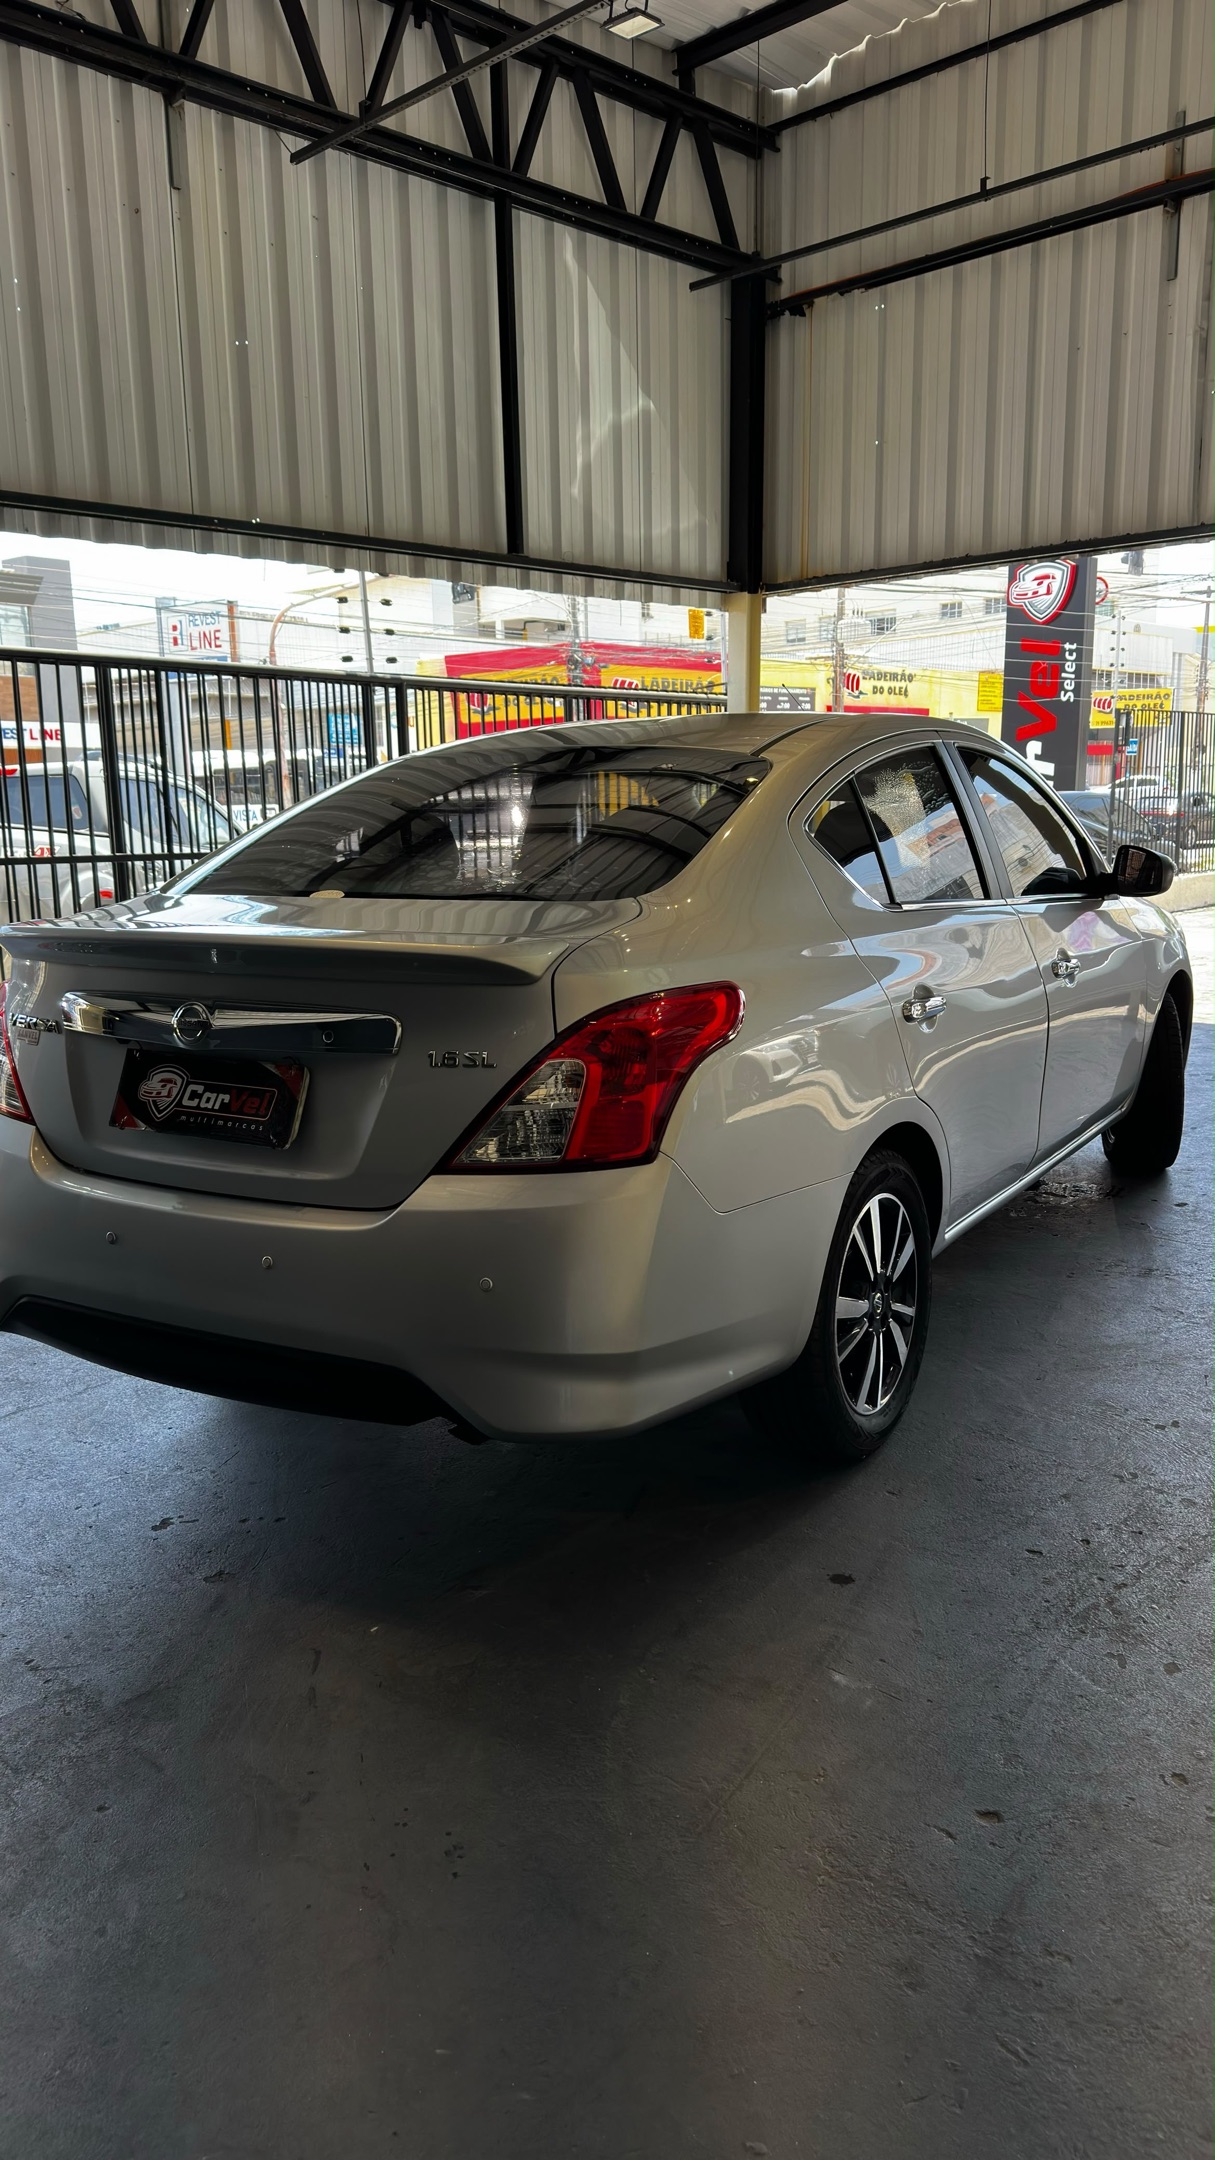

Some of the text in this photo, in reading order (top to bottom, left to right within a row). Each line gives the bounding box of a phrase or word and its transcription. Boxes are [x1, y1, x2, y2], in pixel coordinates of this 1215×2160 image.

[188, 610, 222, 628] REVEST
[189, 629, 223, 651] LINE
[1061, 641, 1077, 703] Select
[872, 685, 885, 695] DO
[1015, 637, 1062, 790] rVel
[29, 728, 62, 741] LNE
[9, 1012, 63, 1035] VERSA
[427, 1050, 498, 1069] 1.6 SL
[181, 1083, 275, 1117] CarVel
[179, 1114, 264, 1132] multimarcas
